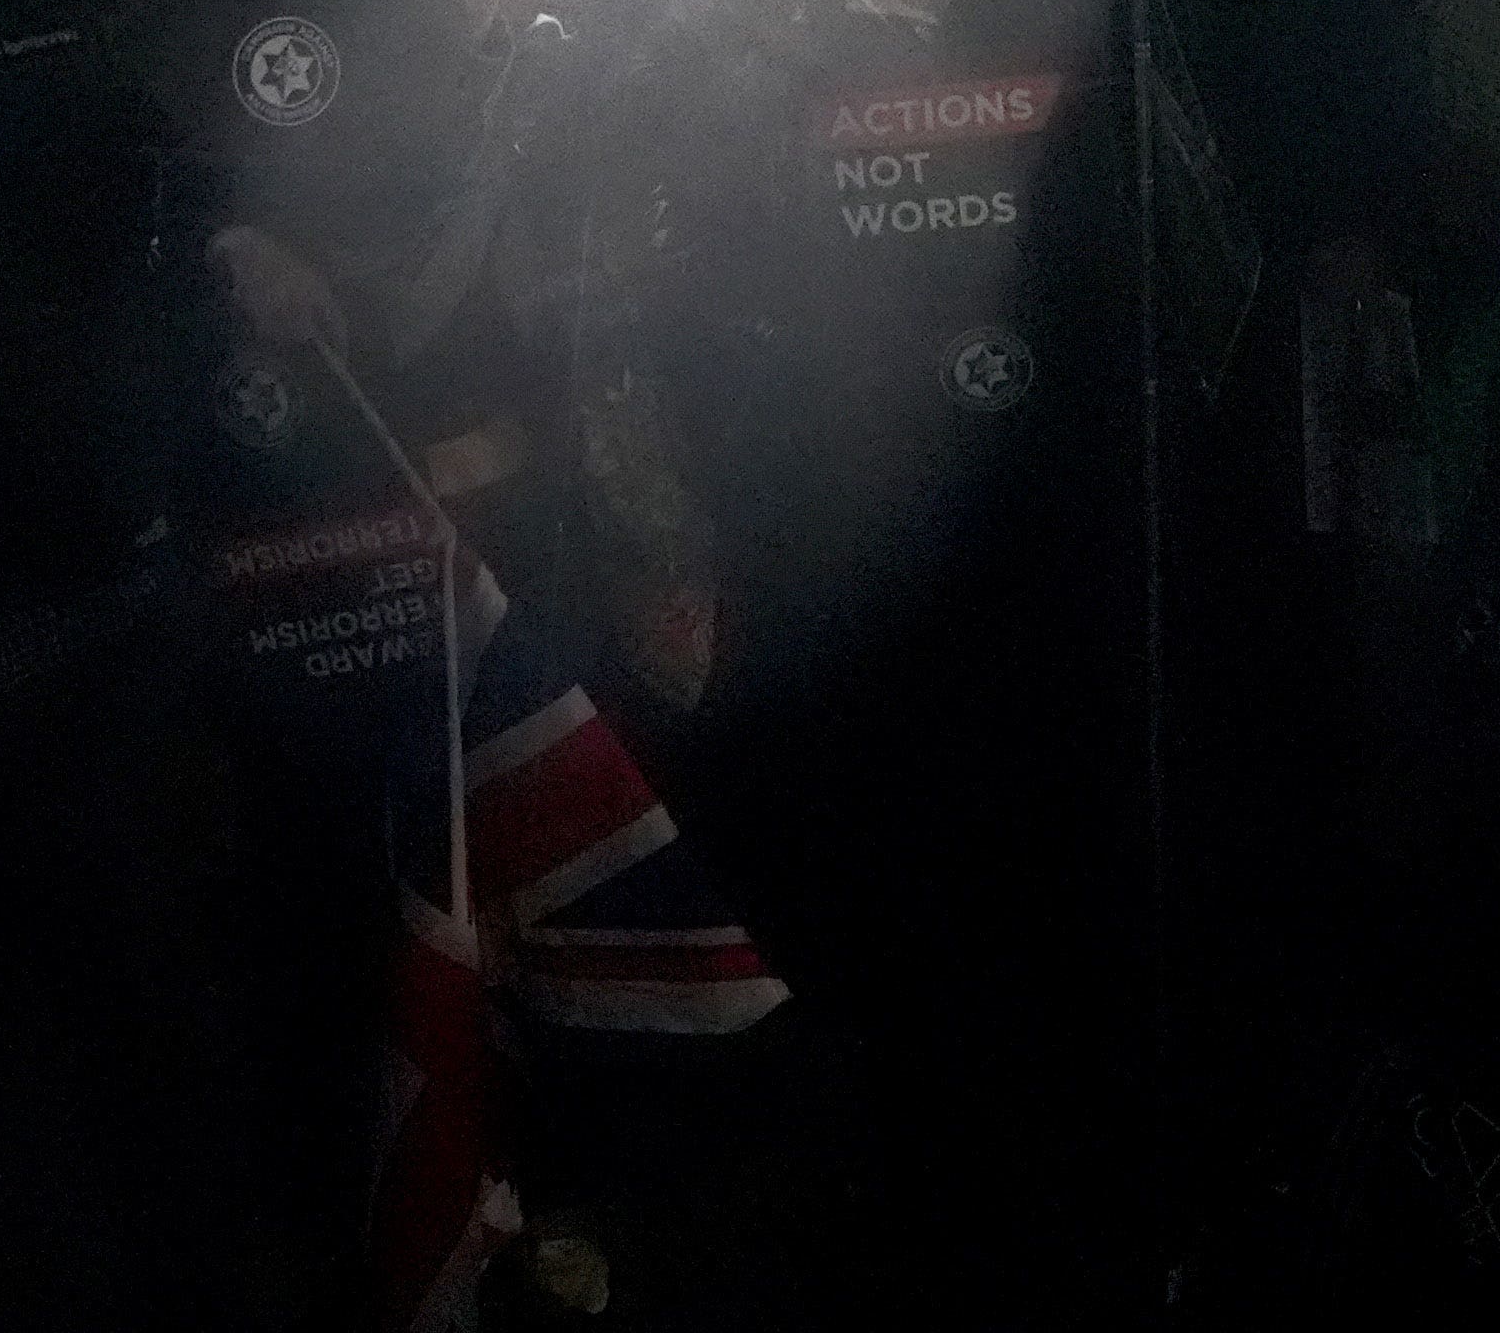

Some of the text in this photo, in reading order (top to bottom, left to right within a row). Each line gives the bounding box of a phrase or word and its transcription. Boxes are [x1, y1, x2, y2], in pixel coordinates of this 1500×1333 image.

[831, 88, 1034, 138] ACTIONS
[835, 152, 930, 191] NOT
[840, 191, 1018, 238] WORDS
[249, 595, 428, 654] ERRORISM
[305, 635, 413, 677] WARD
